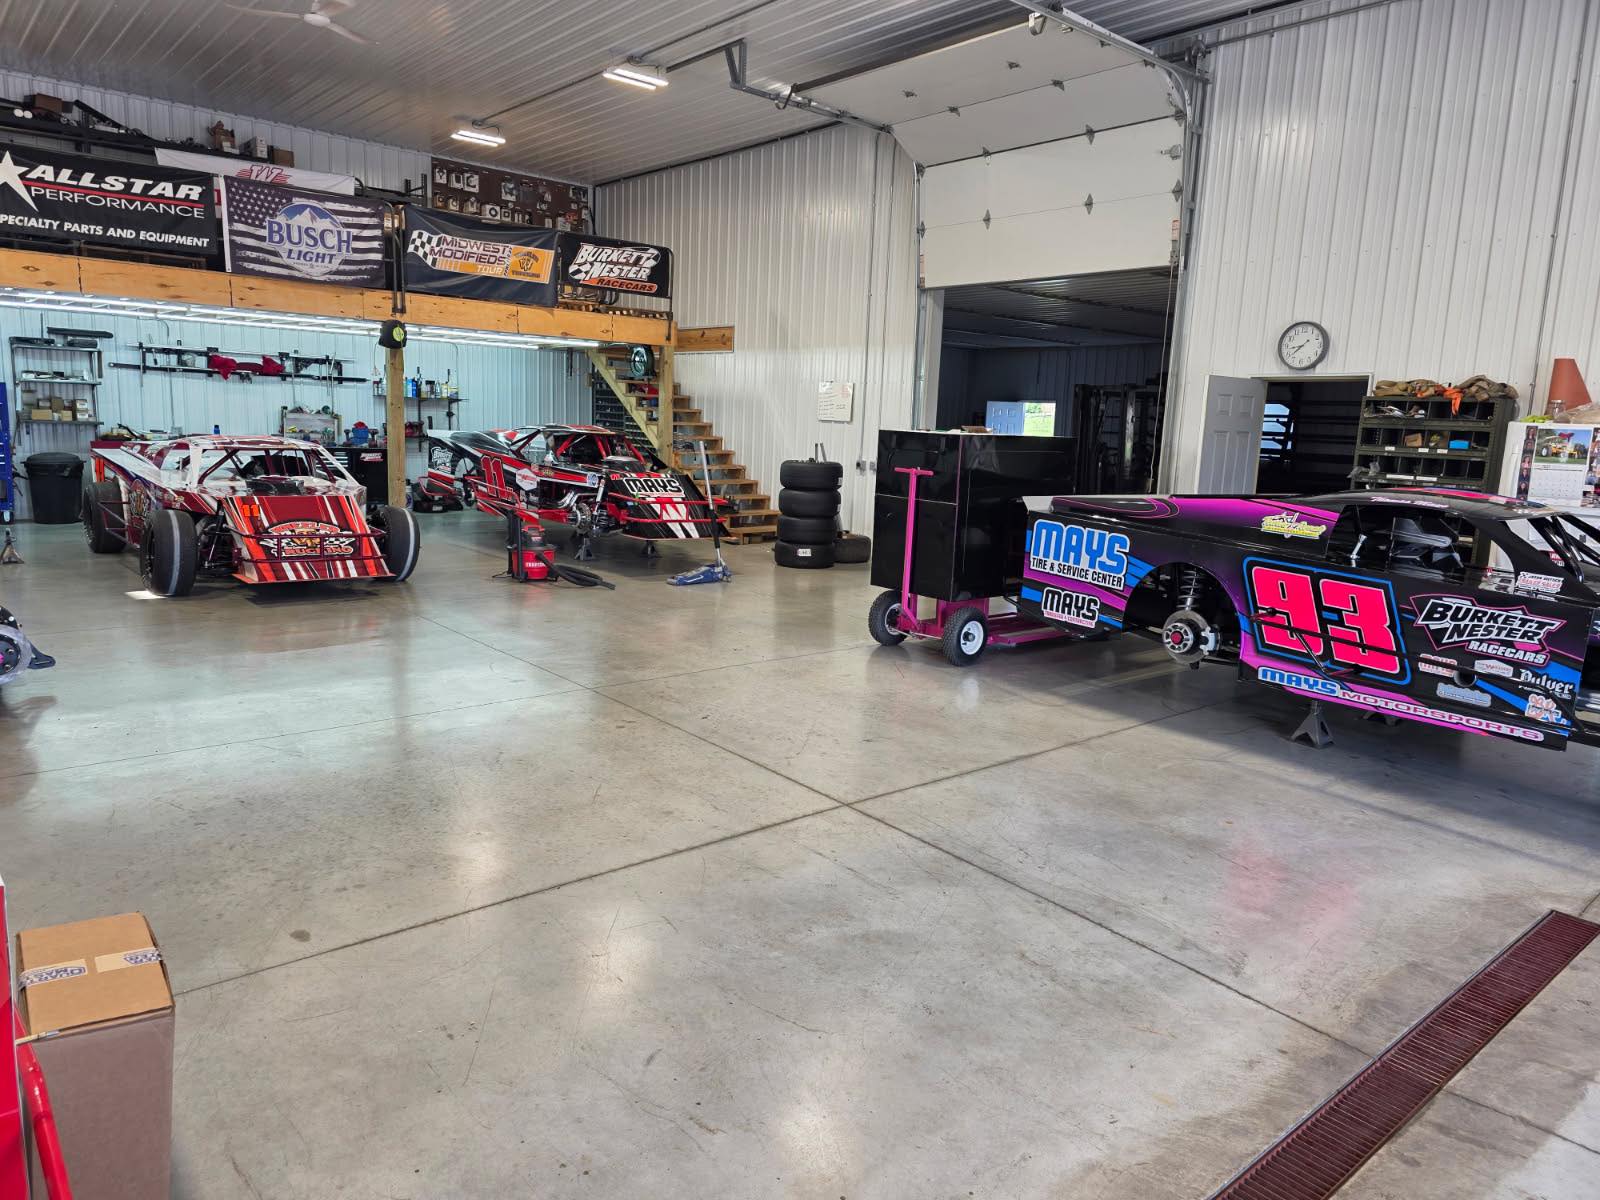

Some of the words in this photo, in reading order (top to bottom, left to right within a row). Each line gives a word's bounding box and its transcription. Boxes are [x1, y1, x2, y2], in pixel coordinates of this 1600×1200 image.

[26, 164, 204, 201] ALLSTAR
[31, 186, 205, 219] PERFORMANCE
[0, 214, 60, 230] PECIALTY
[64, 222, 103, 235] PARTS
[106, 227, 136, 239] AND
[139, 230, 210, 247] EQUIPMENT
[267, 218, 352, 254] BUSCH
[286, 249, 336, 264] LIGHT
[429, 246, 507, 265] MODIFIEDS
[441, 236, 510, 255] MIDWEST
[574, 243, 653, 265] BURKETT
[476, 264, 503, 275] TOUR
[584, 261, 651, 280] NESTER
[597, 279, 654, 292] RACECARS
[480, 455, 508, 501] 11
[624, 478, 683, 493] MAYS
[242, 504, 259, 517] 11
[1031, 520, 1130, 576] MAYS
[1032, 557, 1048, 571] TIRE
[1049, 562, 1054, 571] &
[1057, 563, 1089, 580] SERVICE
[1091, 571, 1123, 588] CENTER
[1043, 588, 1099, 621] MAYS
[1419, 600, 1558, 632] BURKETT
[1252, 566, 1400, 674] 93
[1443, 624, 1542, 643] NESTER
[1468, 641, 1546, 665] RACECARS
[1258, 667, 1340, 697] MAYS
[1341, 690, 1543, 740] MOTORSPORTS
